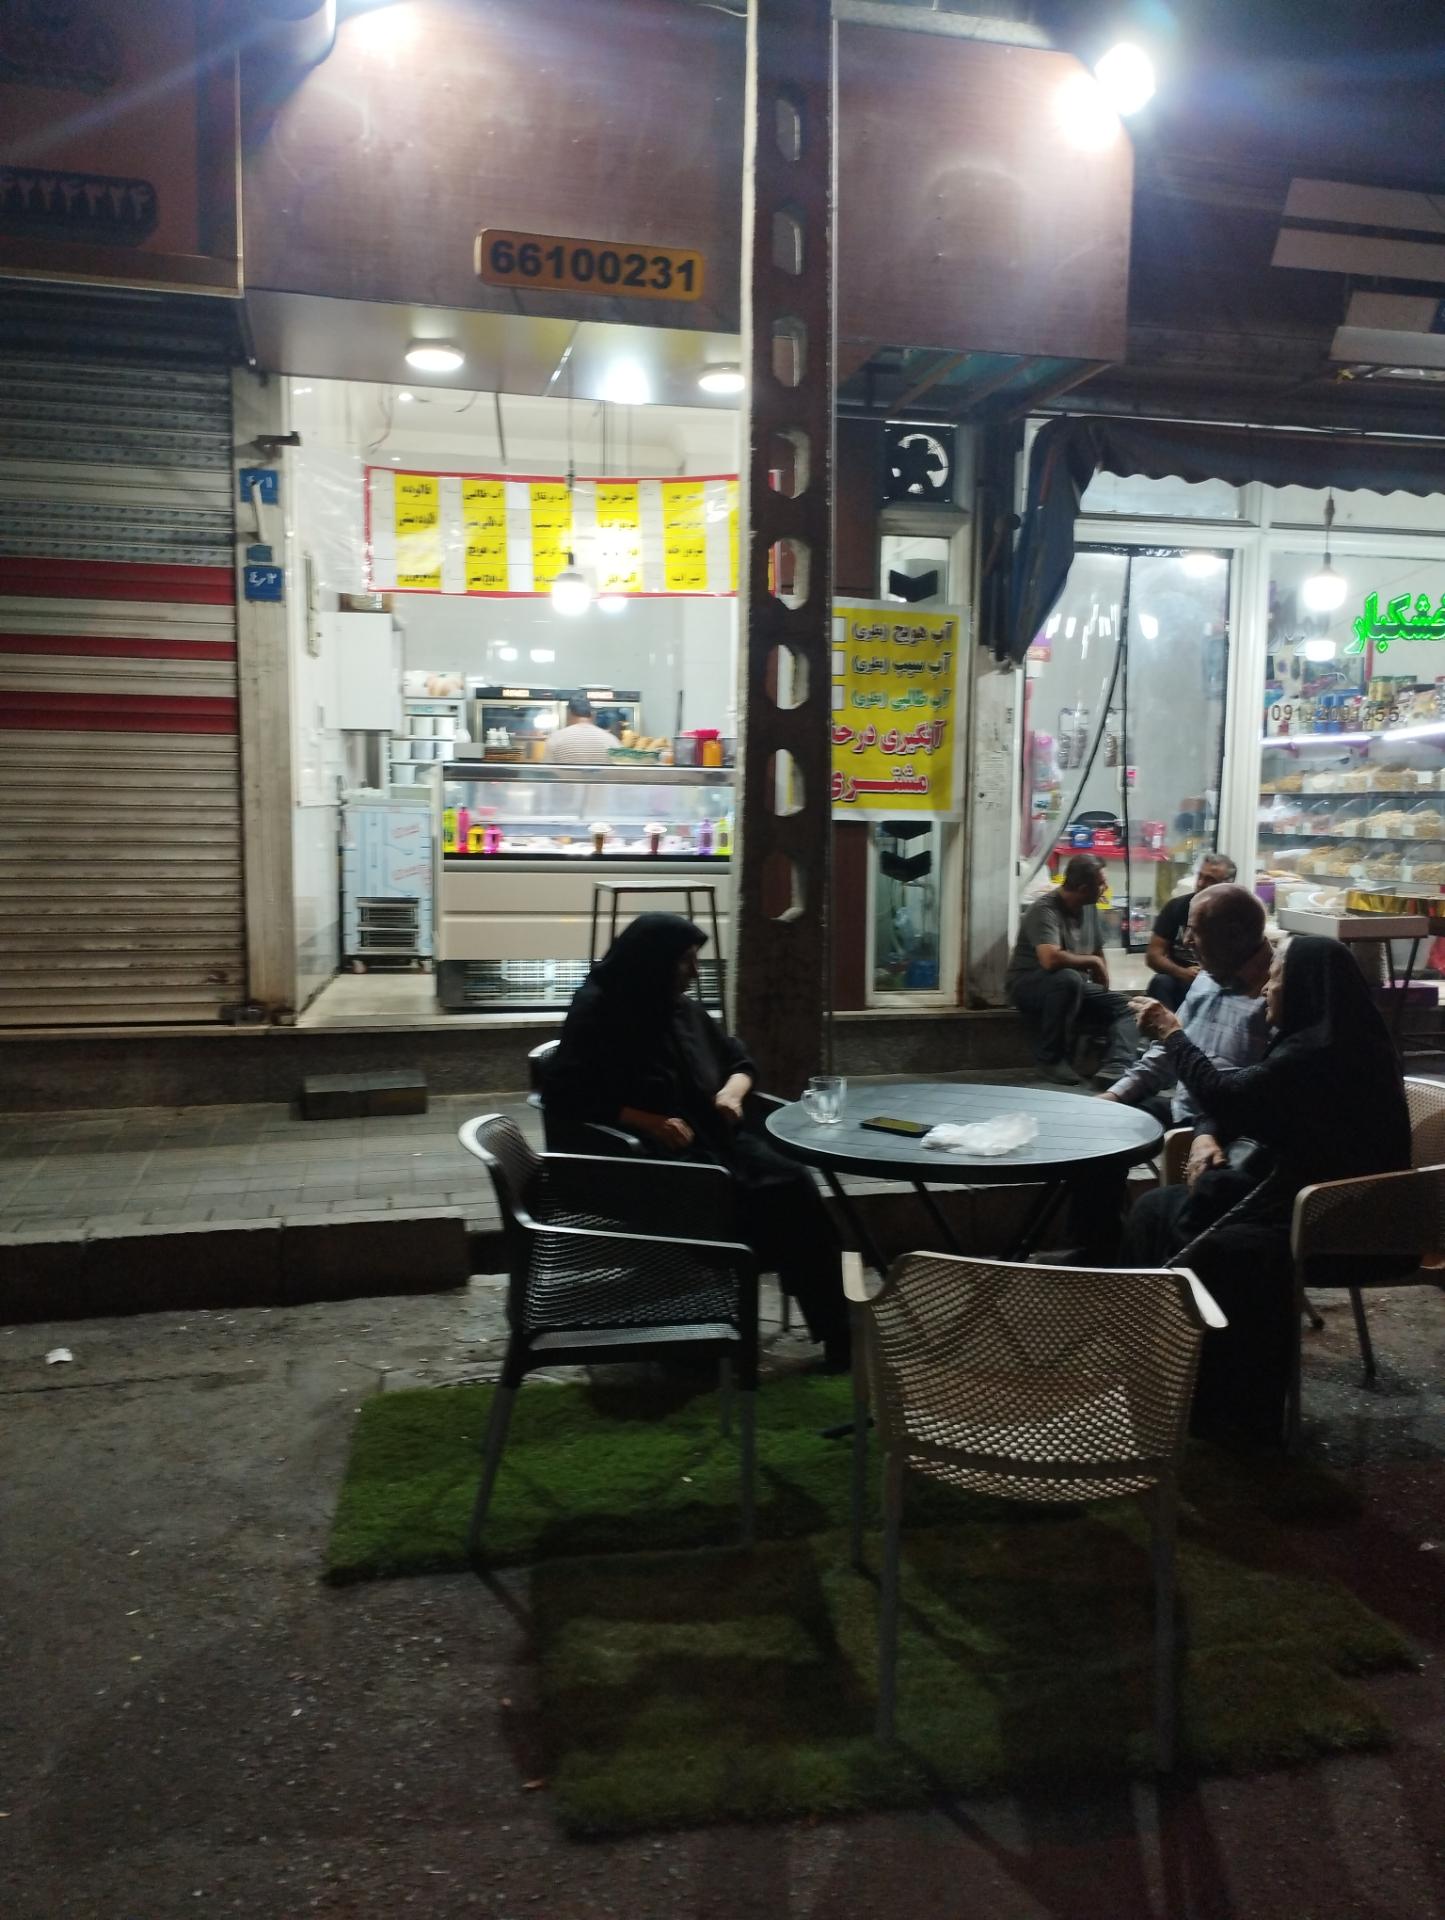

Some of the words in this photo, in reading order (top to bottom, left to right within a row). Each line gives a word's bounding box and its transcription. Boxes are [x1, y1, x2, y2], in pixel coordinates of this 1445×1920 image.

[490, 240, 696, 292] 66100231
[894, 624, 928, 647] هویج
[931, 620, 954, 648] آب
[893, 660, 925, 679] سیب
[928, 651, 952, 680] آب
[891, 687, 928, 711] طالبی
[931, 687, 951, 712] آب
[879, 720, 947, 755] آبگیری
